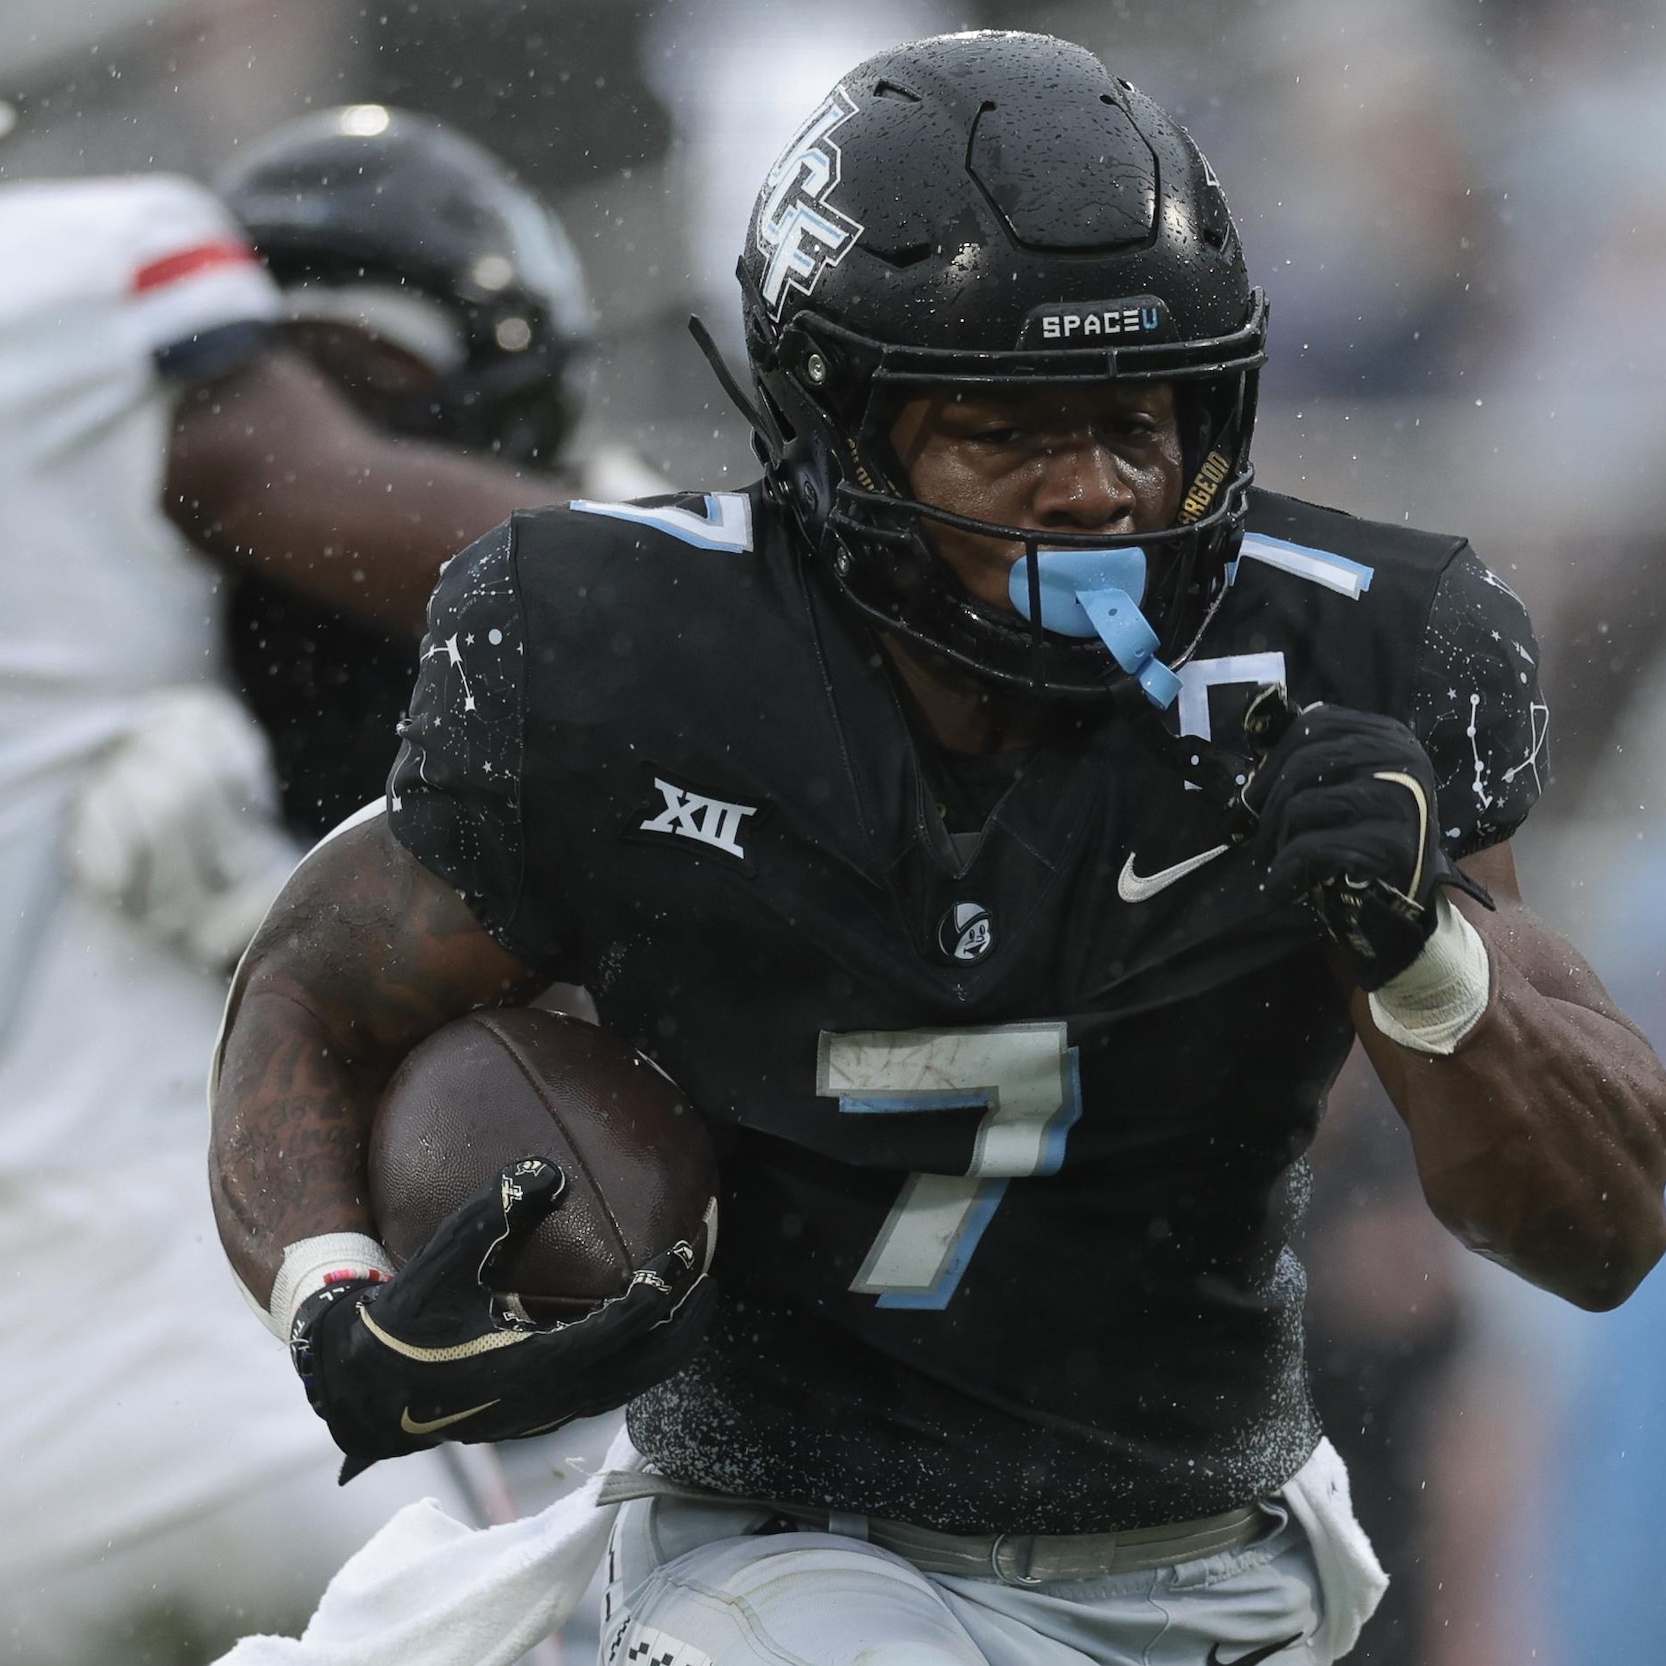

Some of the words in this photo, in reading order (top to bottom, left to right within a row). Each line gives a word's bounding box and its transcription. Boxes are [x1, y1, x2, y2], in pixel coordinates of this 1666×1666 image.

[758, 90, 863, 320] UCF
[1042, 306, 1158, 339] SPACEU
[640, 777, 757, 859] XII
[815, 1021, 1083, 1311] 7
